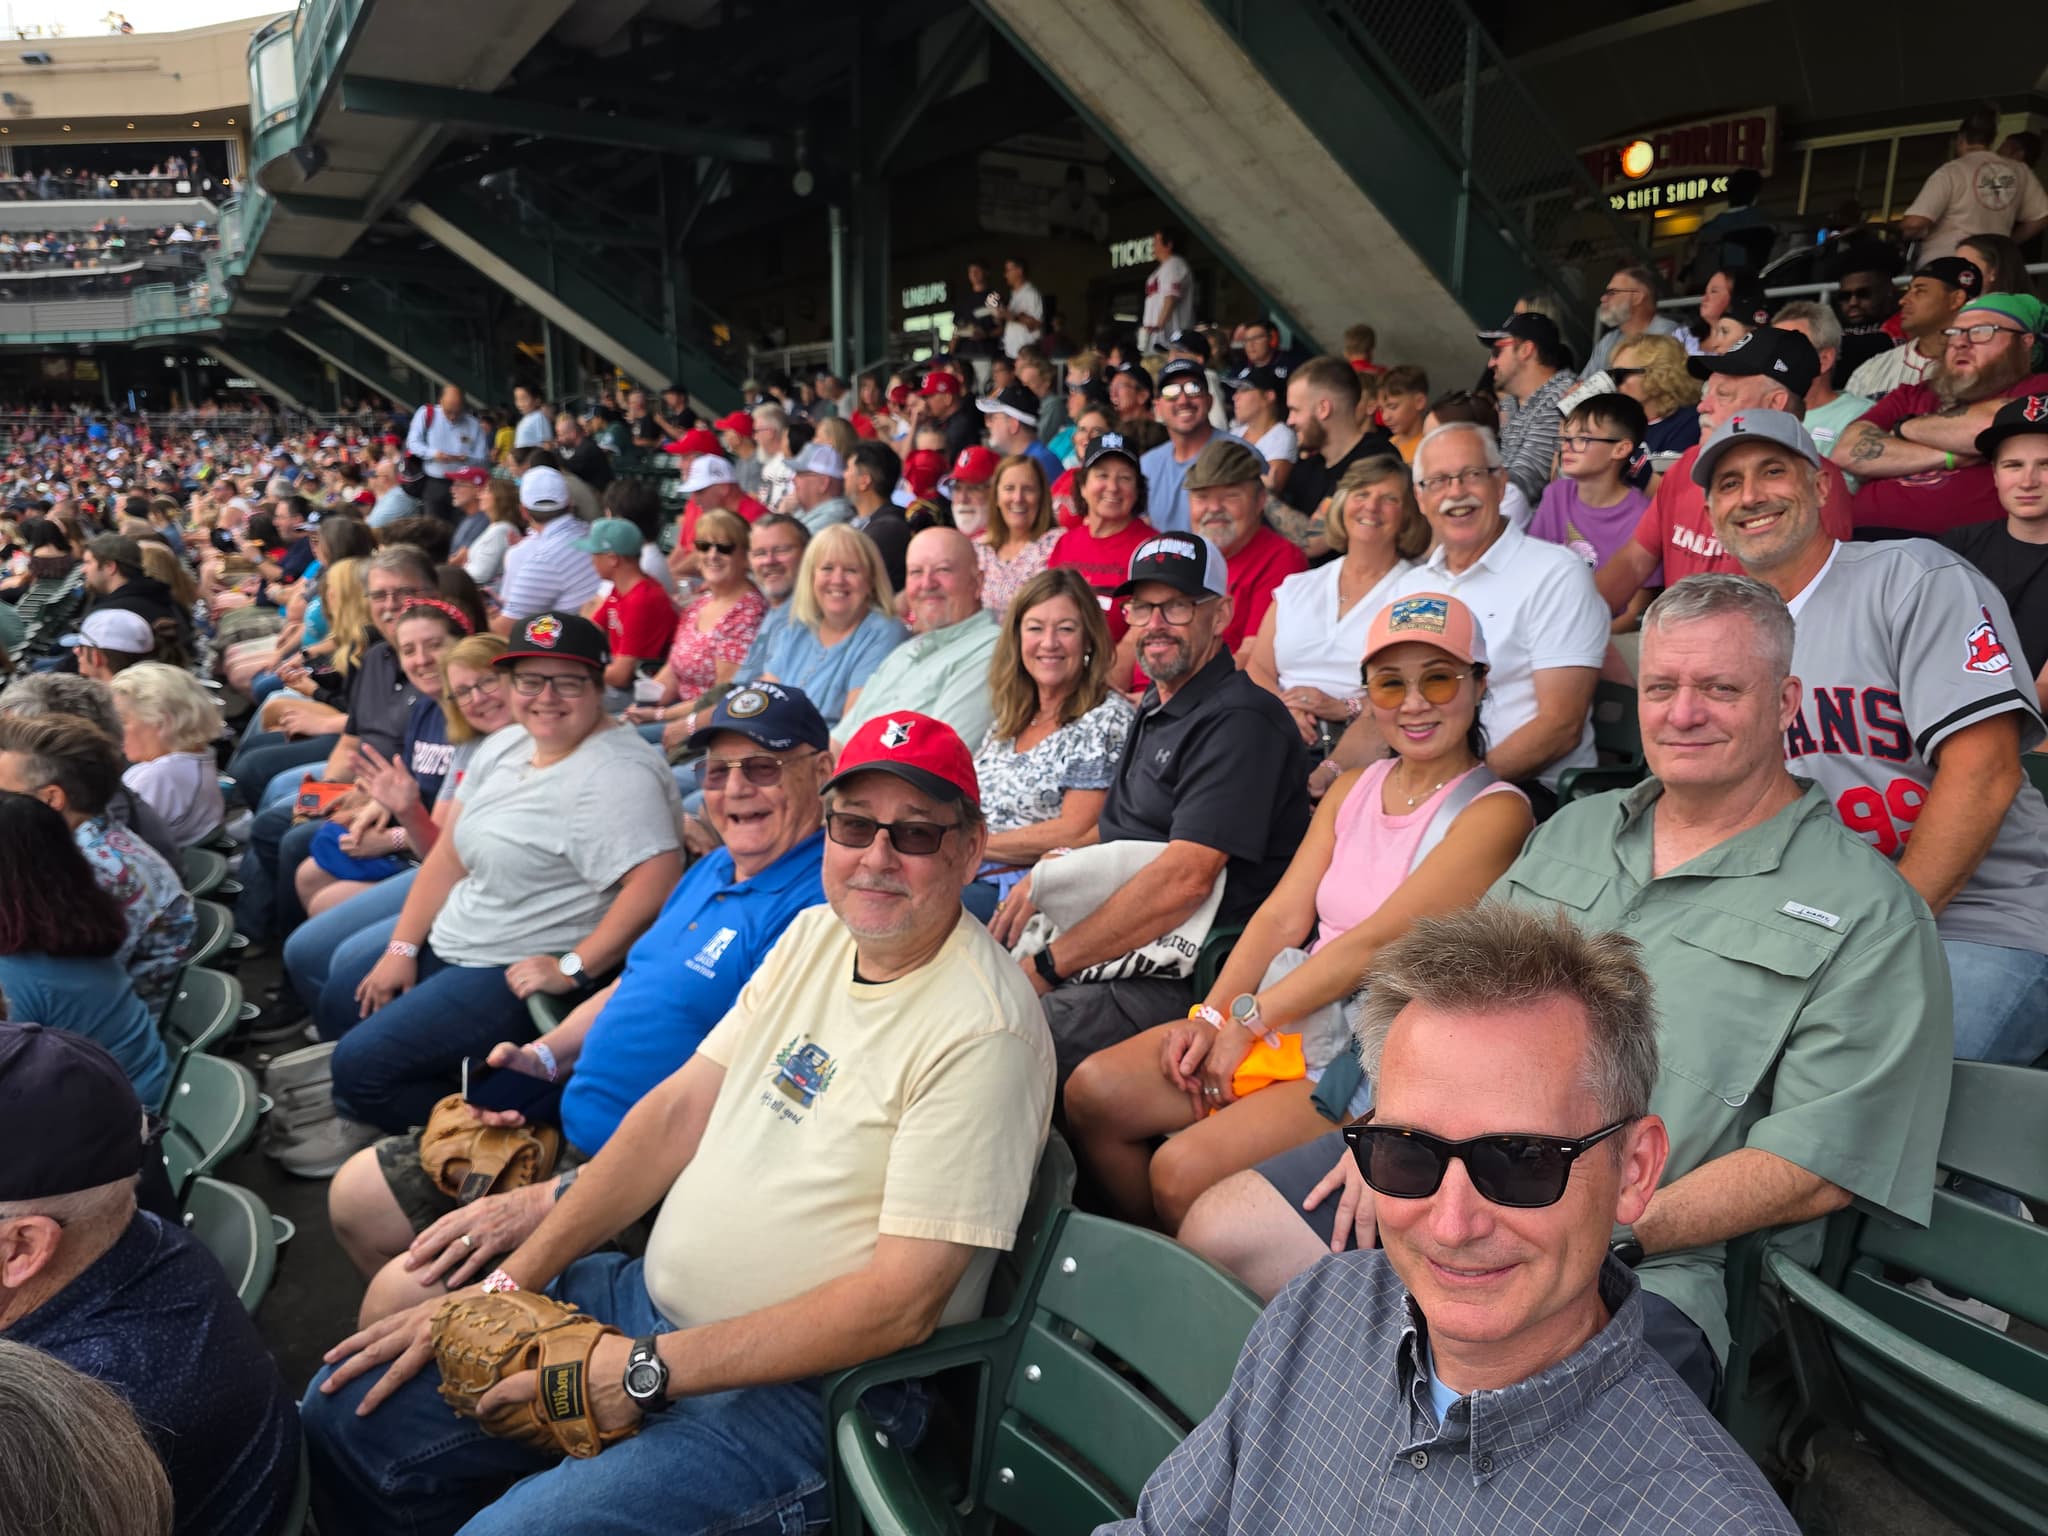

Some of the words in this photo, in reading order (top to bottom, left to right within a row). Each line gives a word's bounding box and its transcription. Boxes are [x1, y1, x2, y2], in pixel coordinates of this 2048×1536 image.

[1626, 187, 1661, 210] GIFT
[1667, 178, 1709, 204] SHOP
[1110, 236, 1156, 269] TICKE
[1784, 686, 1913, 763] ANS
[1836, 777, 1929, 857] 99
